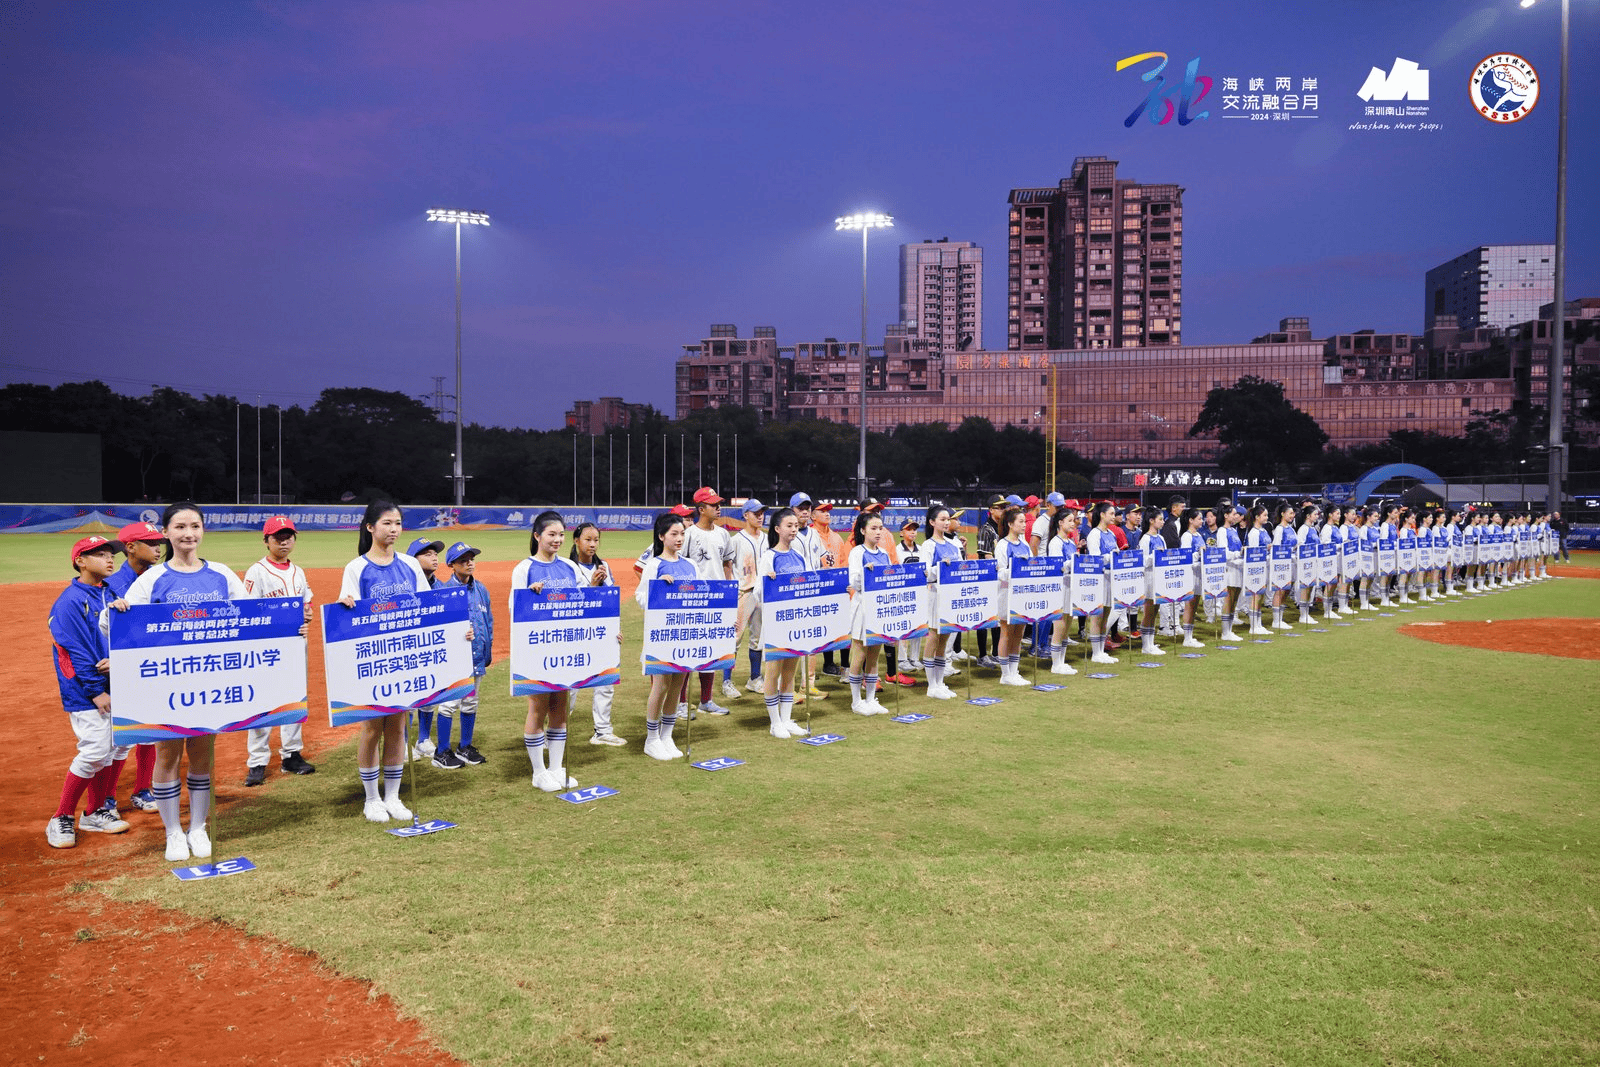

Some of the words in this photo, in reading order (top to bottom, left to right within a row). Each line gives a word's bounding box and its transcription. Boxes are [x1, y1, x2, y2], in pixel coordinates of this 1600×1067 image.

[1341, 384, 1409, 396] 商旅之家
[1205, 478, 1225, 486] Fang
[276, 517, 287, 527] T
[961, 586, 979, 597] 台中市
[351, 604, 445, 626] 第五届海峡两岸学生棒球
[666, 612, 723, 625] 深圳市南山区
[775, 603, 839, 622] 桃园市大园中学
[957, 612, 983, 623] （U15组）
[146, 616, 272, 633] 第五届海峡两岸学生棒球
[379, 617, 422, 631] 联赛总决赛
[883, 619, 912, 634] （U15组）
[182, 628, 240, 641] 联赛总决赛
[528, 626, 607, 645] 台北市福林小学
[650, 626, 736, 642] 教研集团南头城学校
[788, 626, 828, 642] （U15组）
[355, 629, 446, 659] 深圳市南山区
[543, 652, 591, 670] （U12组）
[672, 646, 713, 660] （U12组）
[139, 649, 281, 678] 台北市东园小学
[357, 648, 448, 679] 同乐实验学校
[372, 674, 436, 701] （U12组）
[168, 685, 255, 710] （U12组）
[189, 860, 243, 877] 31
